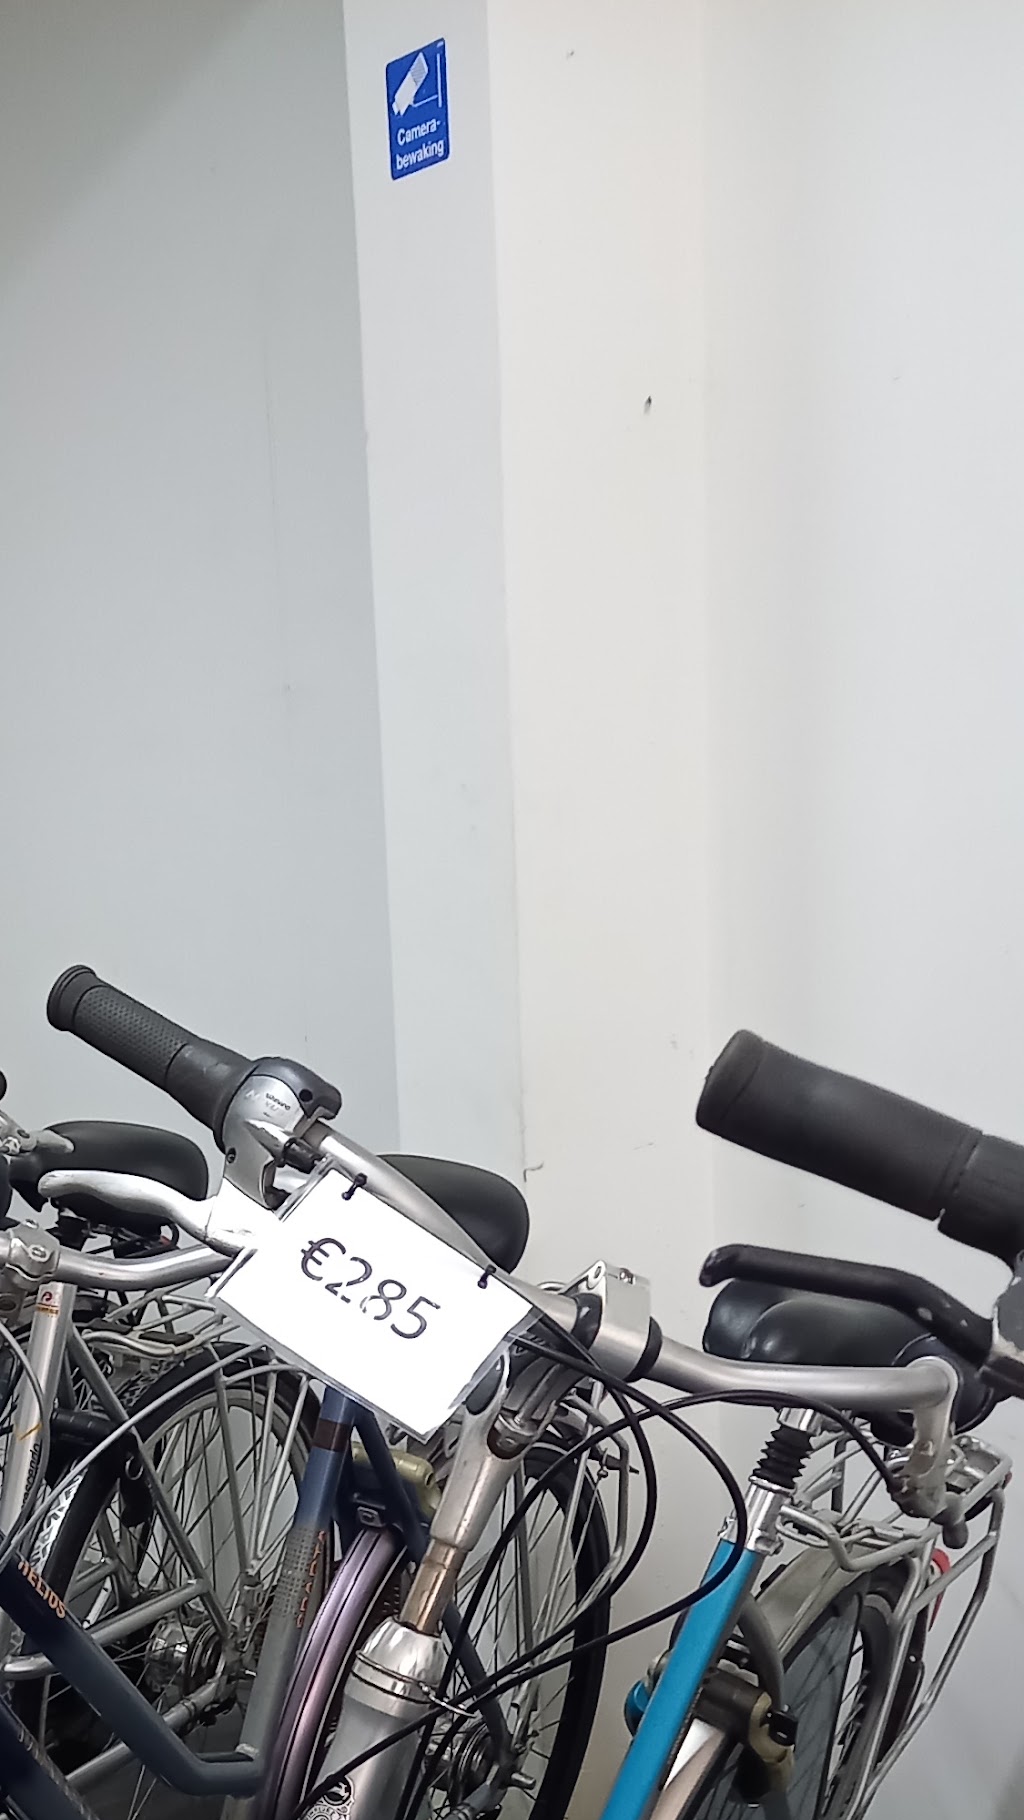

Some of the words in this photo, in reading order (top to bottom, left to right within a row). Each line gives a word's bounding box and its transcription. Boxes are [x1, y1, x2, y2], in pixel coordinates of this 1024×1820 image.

[397, 118, 441, 146] Camera-
[396, 139, 444, 170] bewaking
[300, 1237, 441, 1339] €285
